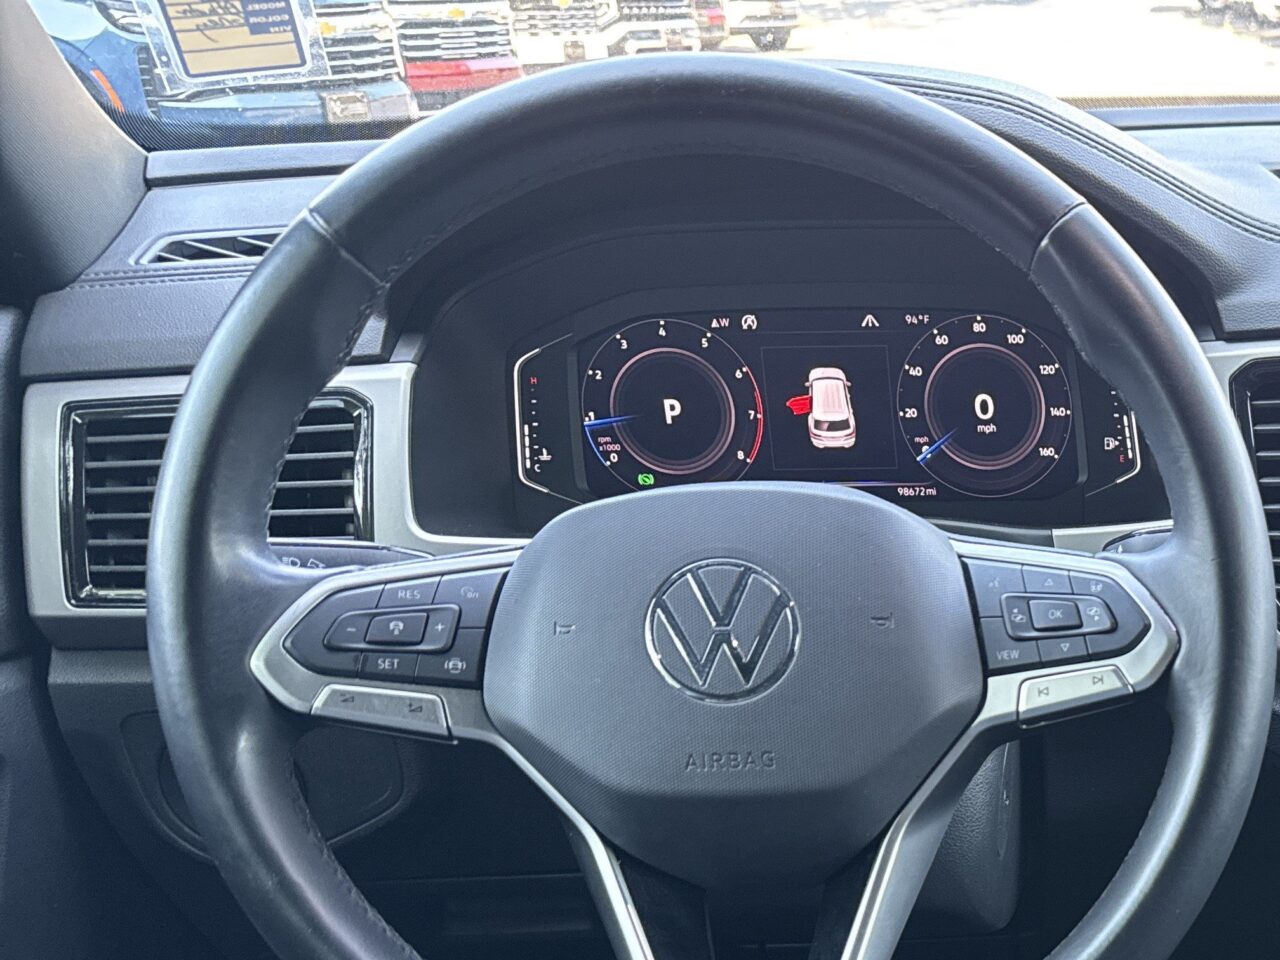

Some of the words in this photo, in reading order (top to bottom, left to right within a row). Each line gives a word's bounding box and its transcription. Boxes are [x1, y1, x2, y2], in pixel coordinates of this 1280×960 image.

[659, 327, 666, 337] 4
[973, 322, 986, 332] 80
[620, 339, 628, 349] 3
[702, 338, 709, 348] 5
[935, 334, 948, 345] 60
[1007, 334, 1024, 344] 100
[595, 370, 602, 380] 2
[735, 370, 742, 379] 6
[909, 366, 922, 376] 40
[1039, 365, 1056, 375] 120
[530, 377, 537, 385] H
[663, 399, 681, 424] P
[974, 393, 994, 420] 0
[589, 411, 595, 421] 1
[748, 411, 755, 420] 7
[905, 408, 917, 418] 20
[1050, 407, 1066, 417] 140
[977, 424, 997, 434] mph
[597, 436, 611, 444] rpm
[914, 436, 929, 444] mph
[737, 451, 744, 460] 8
[1039, 447, 1055, 457] 160
[610, 453, 618, 462] 0
[534, 464, 541, 472] C
[397, 589, 421, 599] RES
[1048, 609, 1063, 619] OK
[996, 650, 1019, 660] VIEW
[377, 659, 399, 669] SET
[685, 751, 776, 772] AIRBAG
